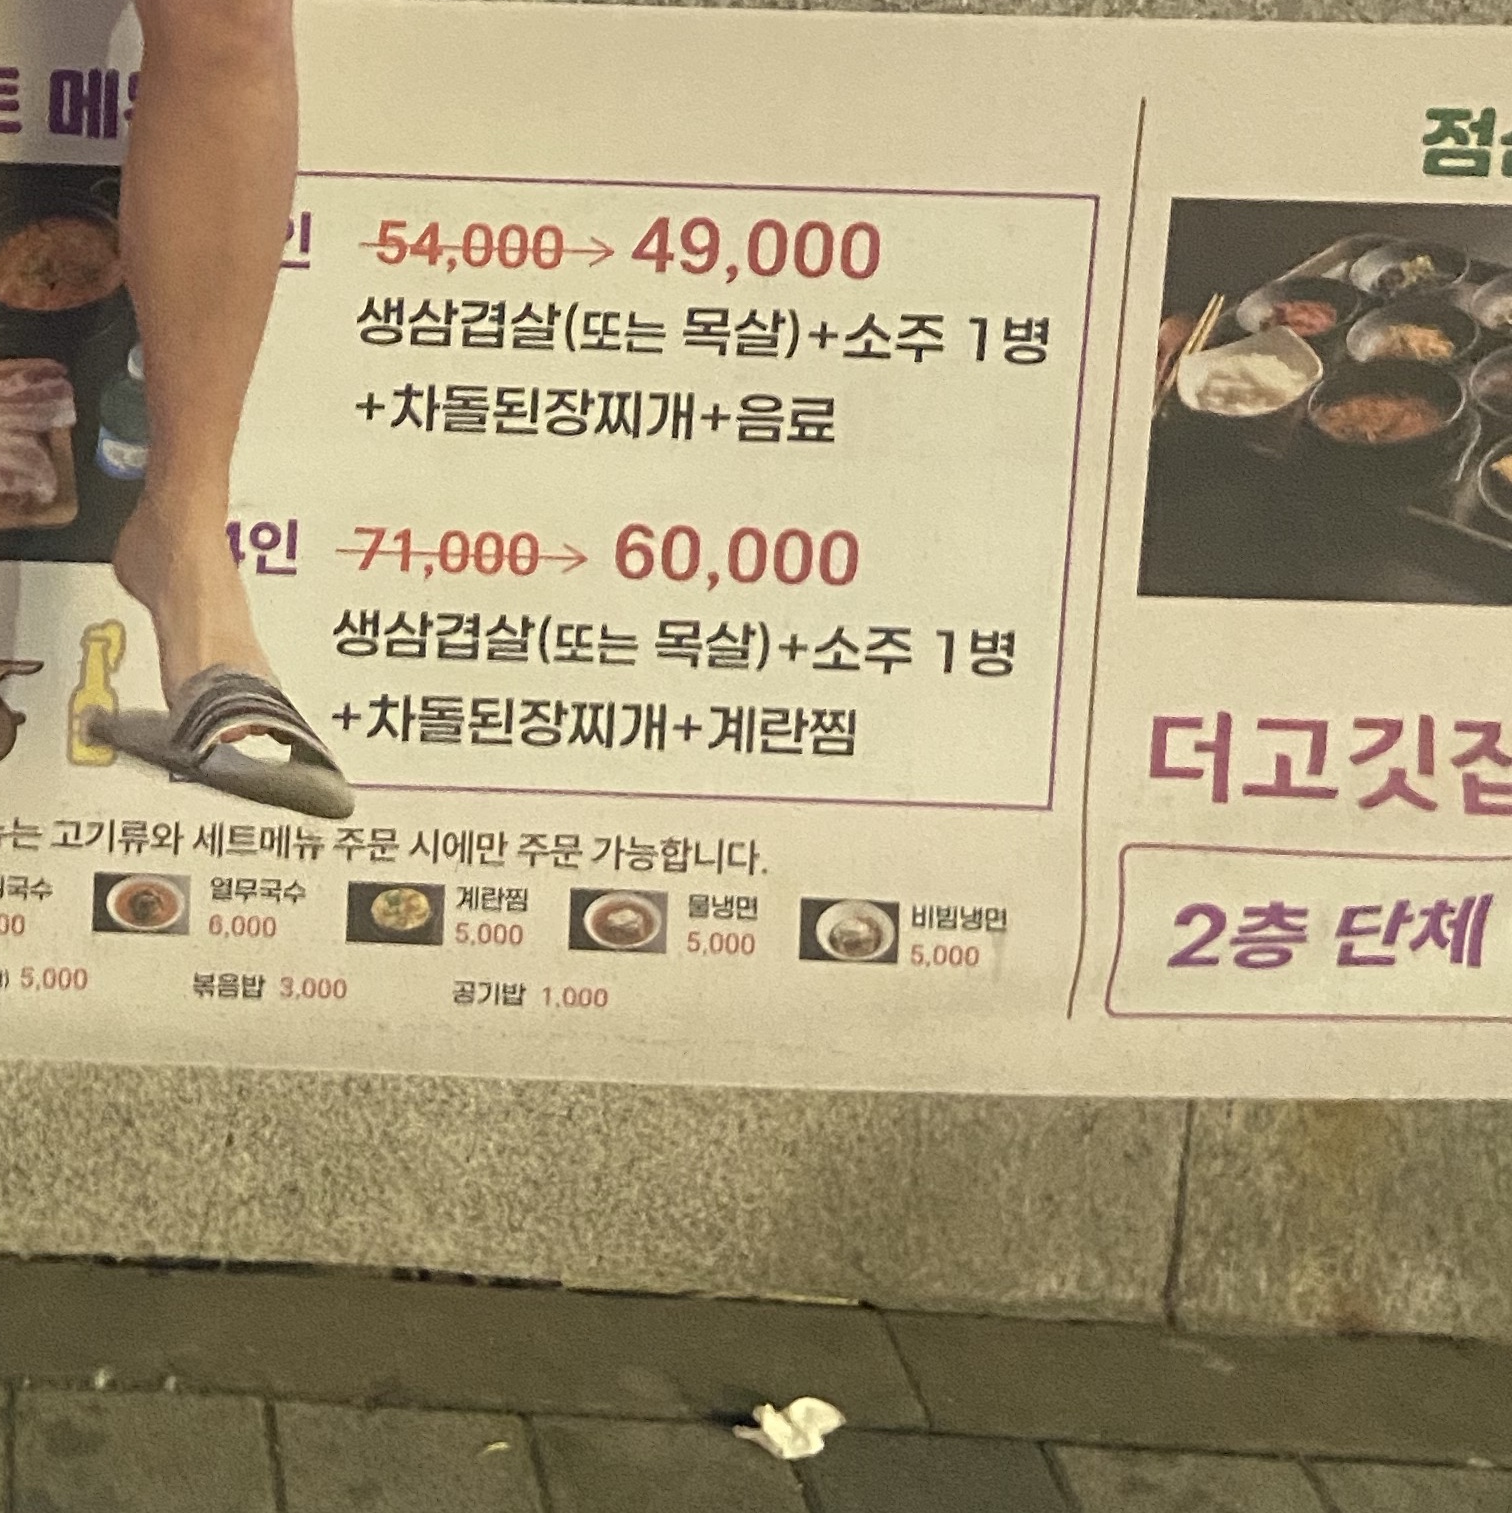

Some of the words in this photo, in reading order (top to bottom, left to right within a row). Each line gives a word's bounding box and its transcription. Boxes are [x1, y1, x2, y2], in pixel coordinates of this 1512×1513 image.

[1422, 106, 1512, 177] 점
[376, 219, 564, 272] 54,000
[631, 216, 881, 283] 49,000
[354, 526, 540, 581] 71,000
[615, 523, 859, 592] 60,000
[50, 820, 184, 856] 고기류와
[192, 822, 324, 861] 세트메뉴
[333, 827, 399, 864] 주문
[409, 828, 508, 867] 시에만
[517, 833, 583, 869] 주문
[591, 834, 768, 876] 가능합니다.
[210, 876, 306, 905] 열무국수
[456, 885, 529, 913] 계란찜
[689, 893, 758, 920] 물냉면
[911, 904, 1008, 932] 비빔냉면
[208, 914, 276, 939] 6,000
[455, 922, 524, 946] 5,000
[1167, 900, 1309, 970] 2층
[1335, 893, 1493, 968] 단체
[687, 930, 756, 956] 5,000
[910, 944, 980, 967] 5,000
[20, 966, 88, 991] 5,000
[193, 972, 266, 1000] 볶음밥
[280, 976, 348, 1000] 3,000
[453, 980, 526, 1006] 공기밥
[542, 986, 608, 1009] 1,000
